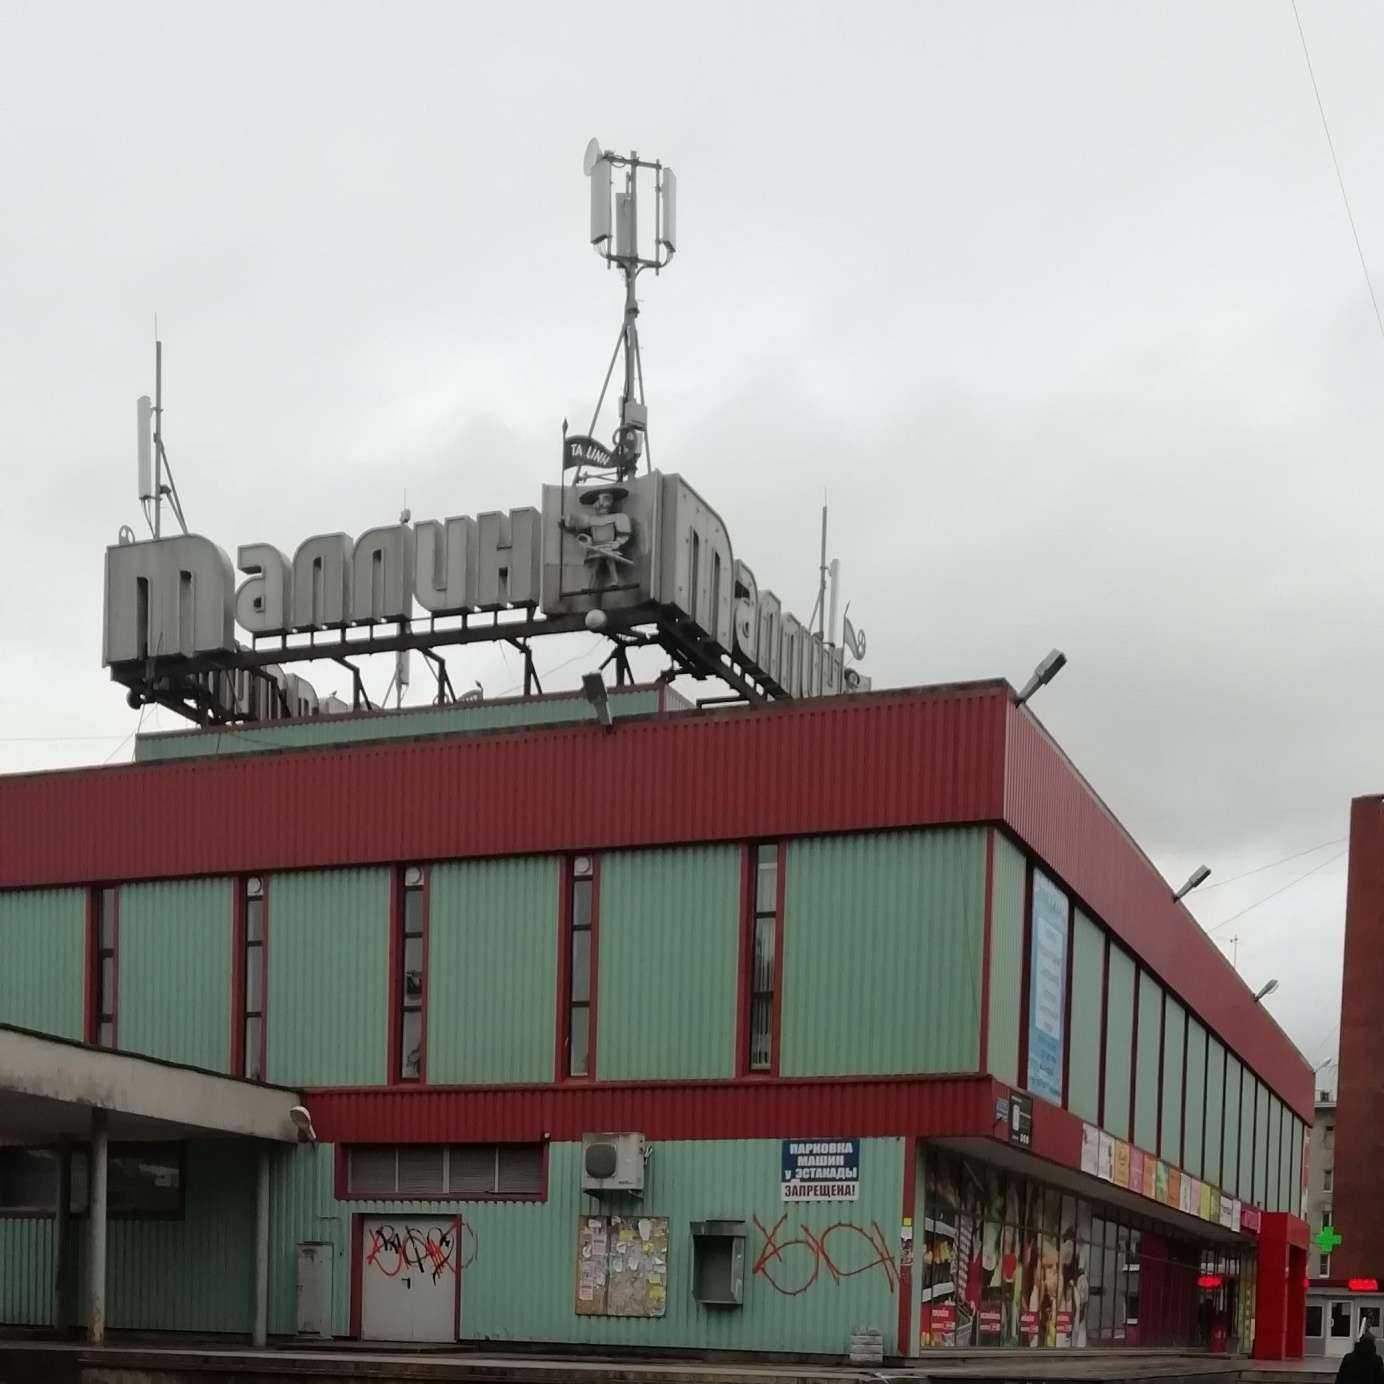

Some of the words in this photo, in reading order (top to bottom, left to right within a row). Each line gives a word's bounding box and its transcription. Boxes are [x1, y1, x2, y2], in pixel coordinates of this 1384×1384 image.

[790, 1142, 853, 1154] ПАРКОВКА
[797, 1155, 844, 1167] МАШИН
[795, 1167, 857, 1180] ЭСТАКАДЫ
[785, 1185, 856, 1197] ЗАПРЕЩЕНА!
